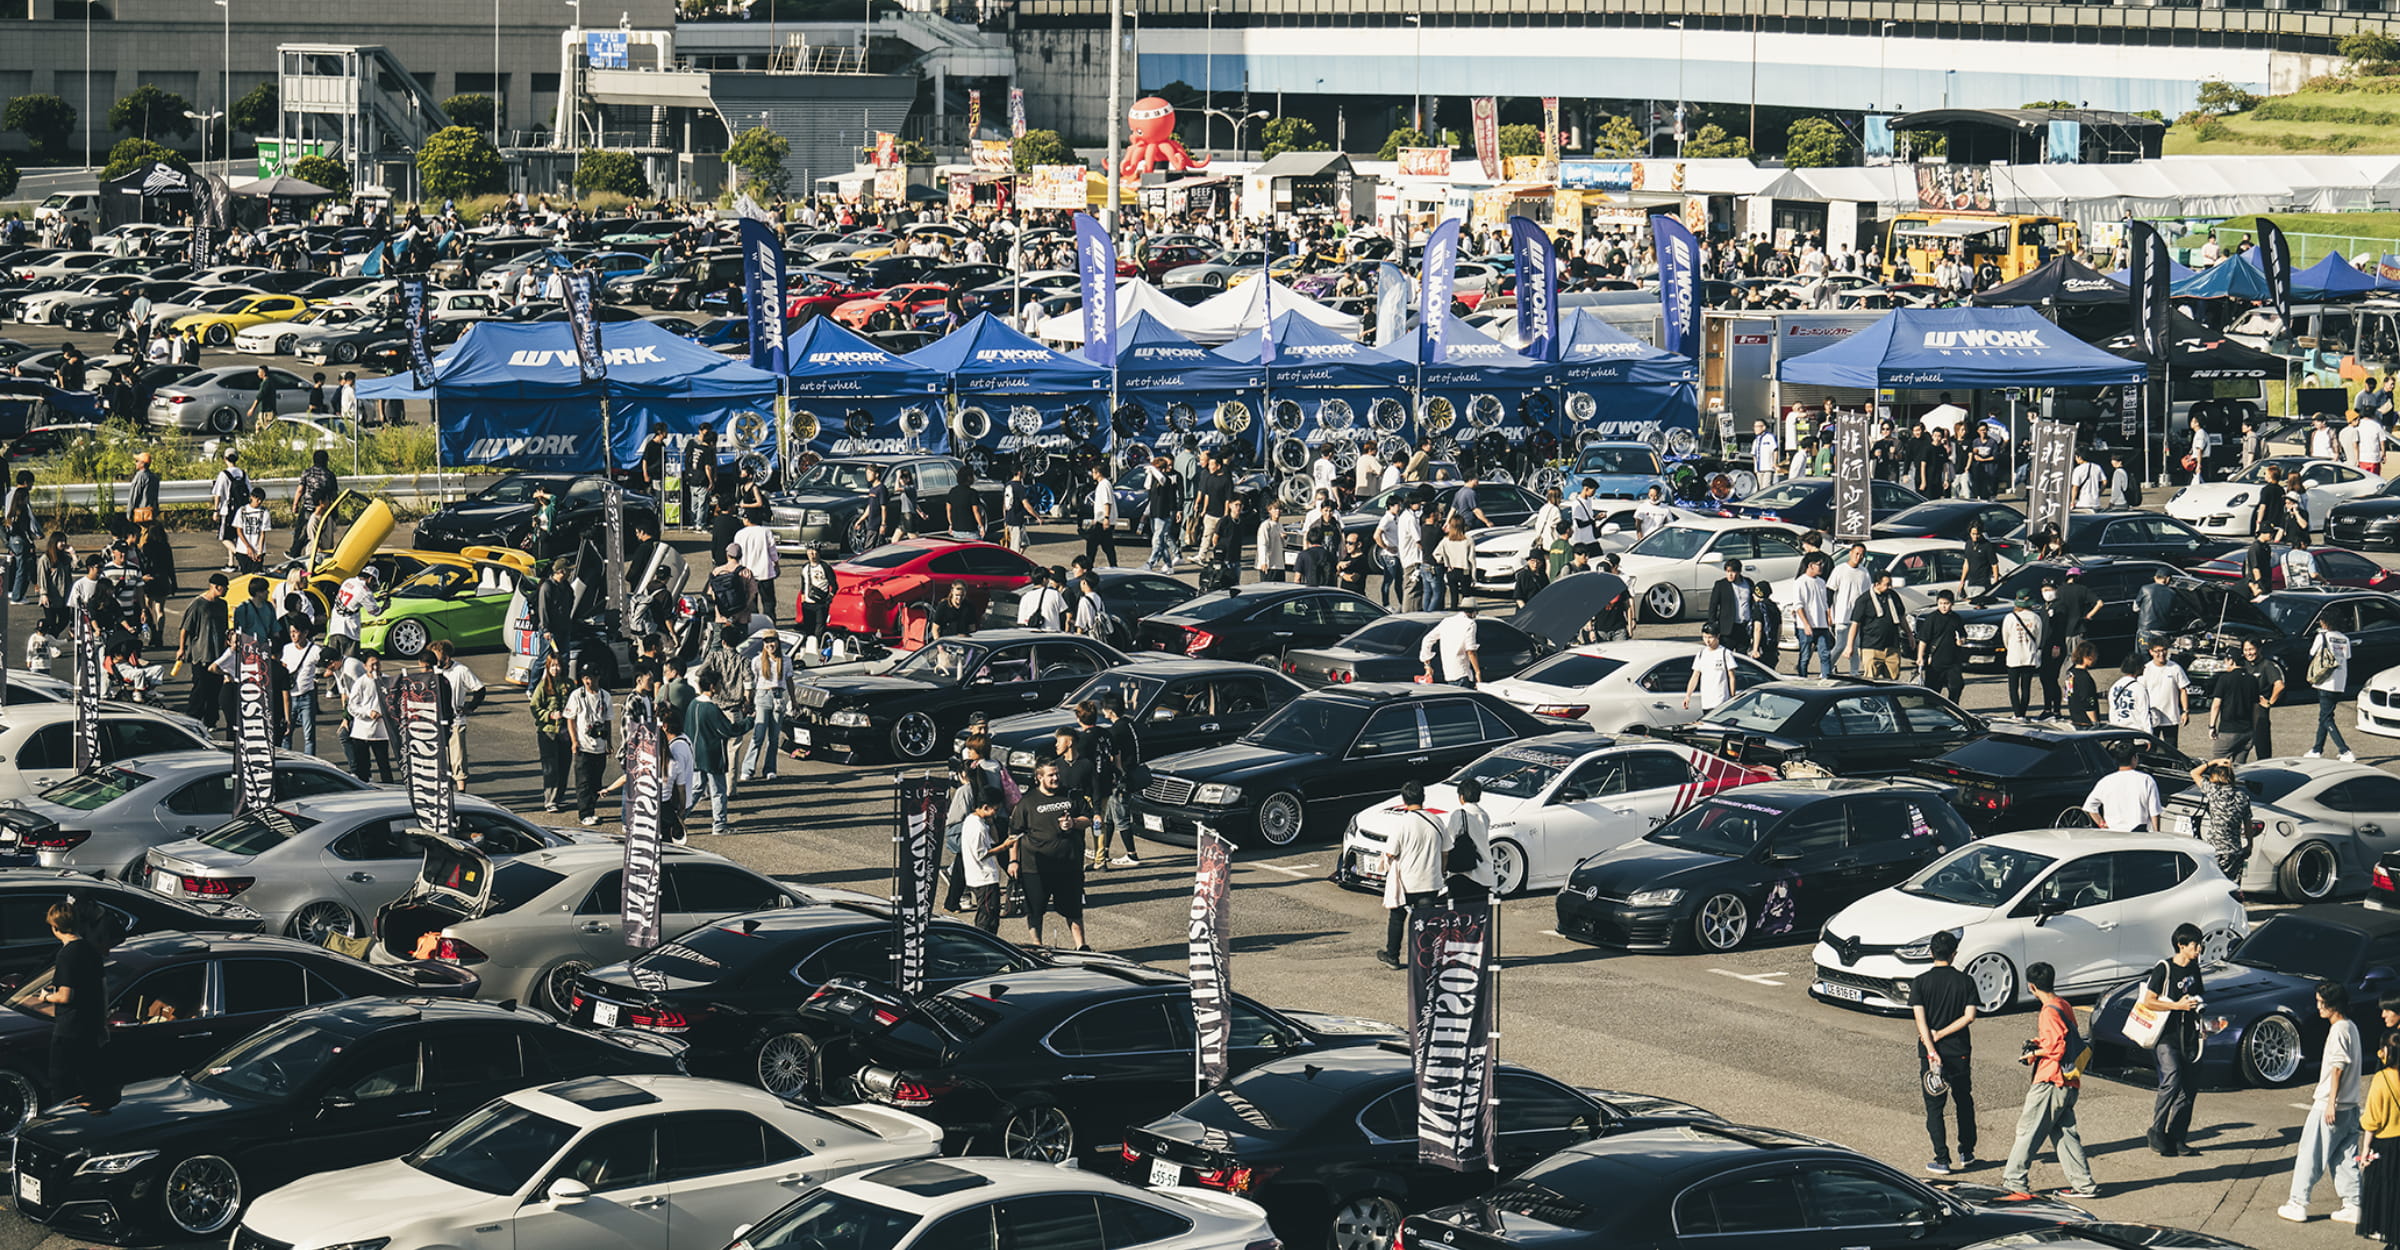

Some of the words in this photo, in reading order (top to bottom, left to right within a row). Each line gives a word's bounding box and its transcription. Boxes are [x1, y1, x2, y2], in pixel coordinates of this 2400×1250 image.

[1664, 245, 1678, 327] WHEELS
[1093, 274, 1106, 344] WORK
[1530, 273, 1549, 340] WORK
[1677, 271, 1692, 336] WORK
[761, 278, 784, 352] WORK
[1962, 329, 2043, 348] WORK
[1158, 347, 1206, 358] WORK
[1307, 343, 1356, 356] WORK
[1459, 343, 1502, 353] WORK
[1596, 343, 1642, 352] WORK
[833, 351, 891, 363] WORK
[1000, 349, 1054, 361] WORK
[1277, 371, 1291, 380] art
[1292, 370, 1301, 382] of
[1427, 374, 1441, 382] art
[1442, 373, 1451, 385] of
[1568, 369, 1581, 377] art
[1582, 368, 1591, 380] of
[1890, 375, 1904, 383] art
[1904, 373, 1914, 385] of
[2191, 369, 2267, 379] NITTO
[800, 381, 815, 391] art
[817, 380, 826, 393] of
[970, 379, 986, 388] art
[988, 377, 997, 389] of
[1126, 378, 1142, 387] art
[1142, 376, 1152, 389] of
[502, 434, 578, 457] WORK
[1841, 430, 1865, 534] 非行少年
[2037, 441, 2066, 533] 非行少
[901, 907, 917, 996] FAMILY
